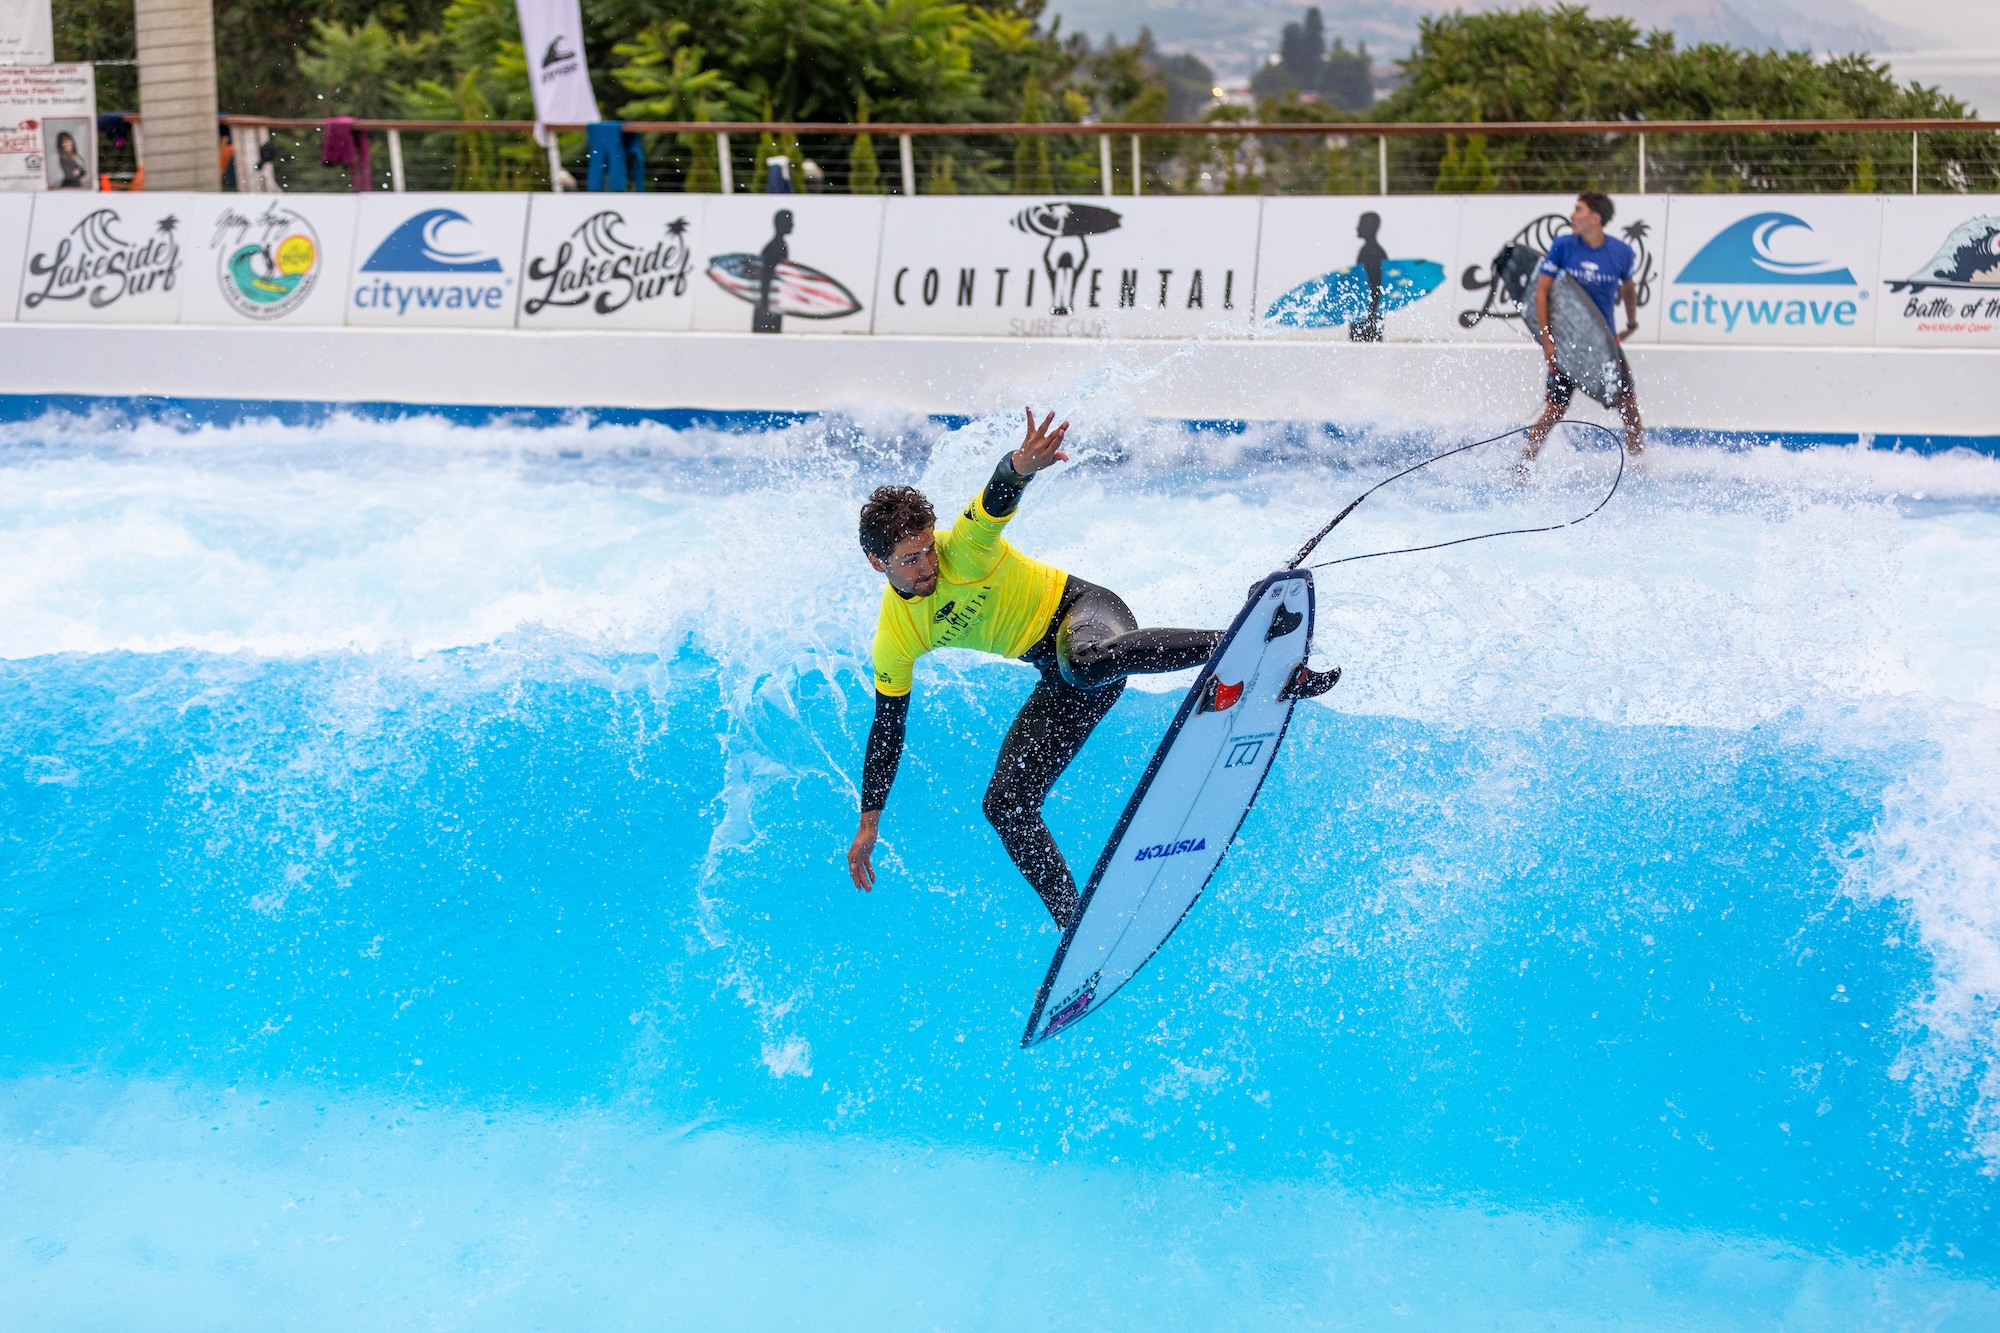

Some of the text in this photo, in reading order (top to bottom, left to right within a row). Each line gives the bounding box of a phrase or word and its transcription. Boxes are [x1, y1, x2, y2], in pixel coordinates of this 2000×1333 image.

[354, 278, 503, 316] citywave
[1903, 296, 1955, 318] Battle
[1960, 296, 1985, 318] of
[1668, 290, 1857, 333] citywave
[1009, 317, 1059, 337] SURF
[1134, 837, 1206, 862] VISITOR
